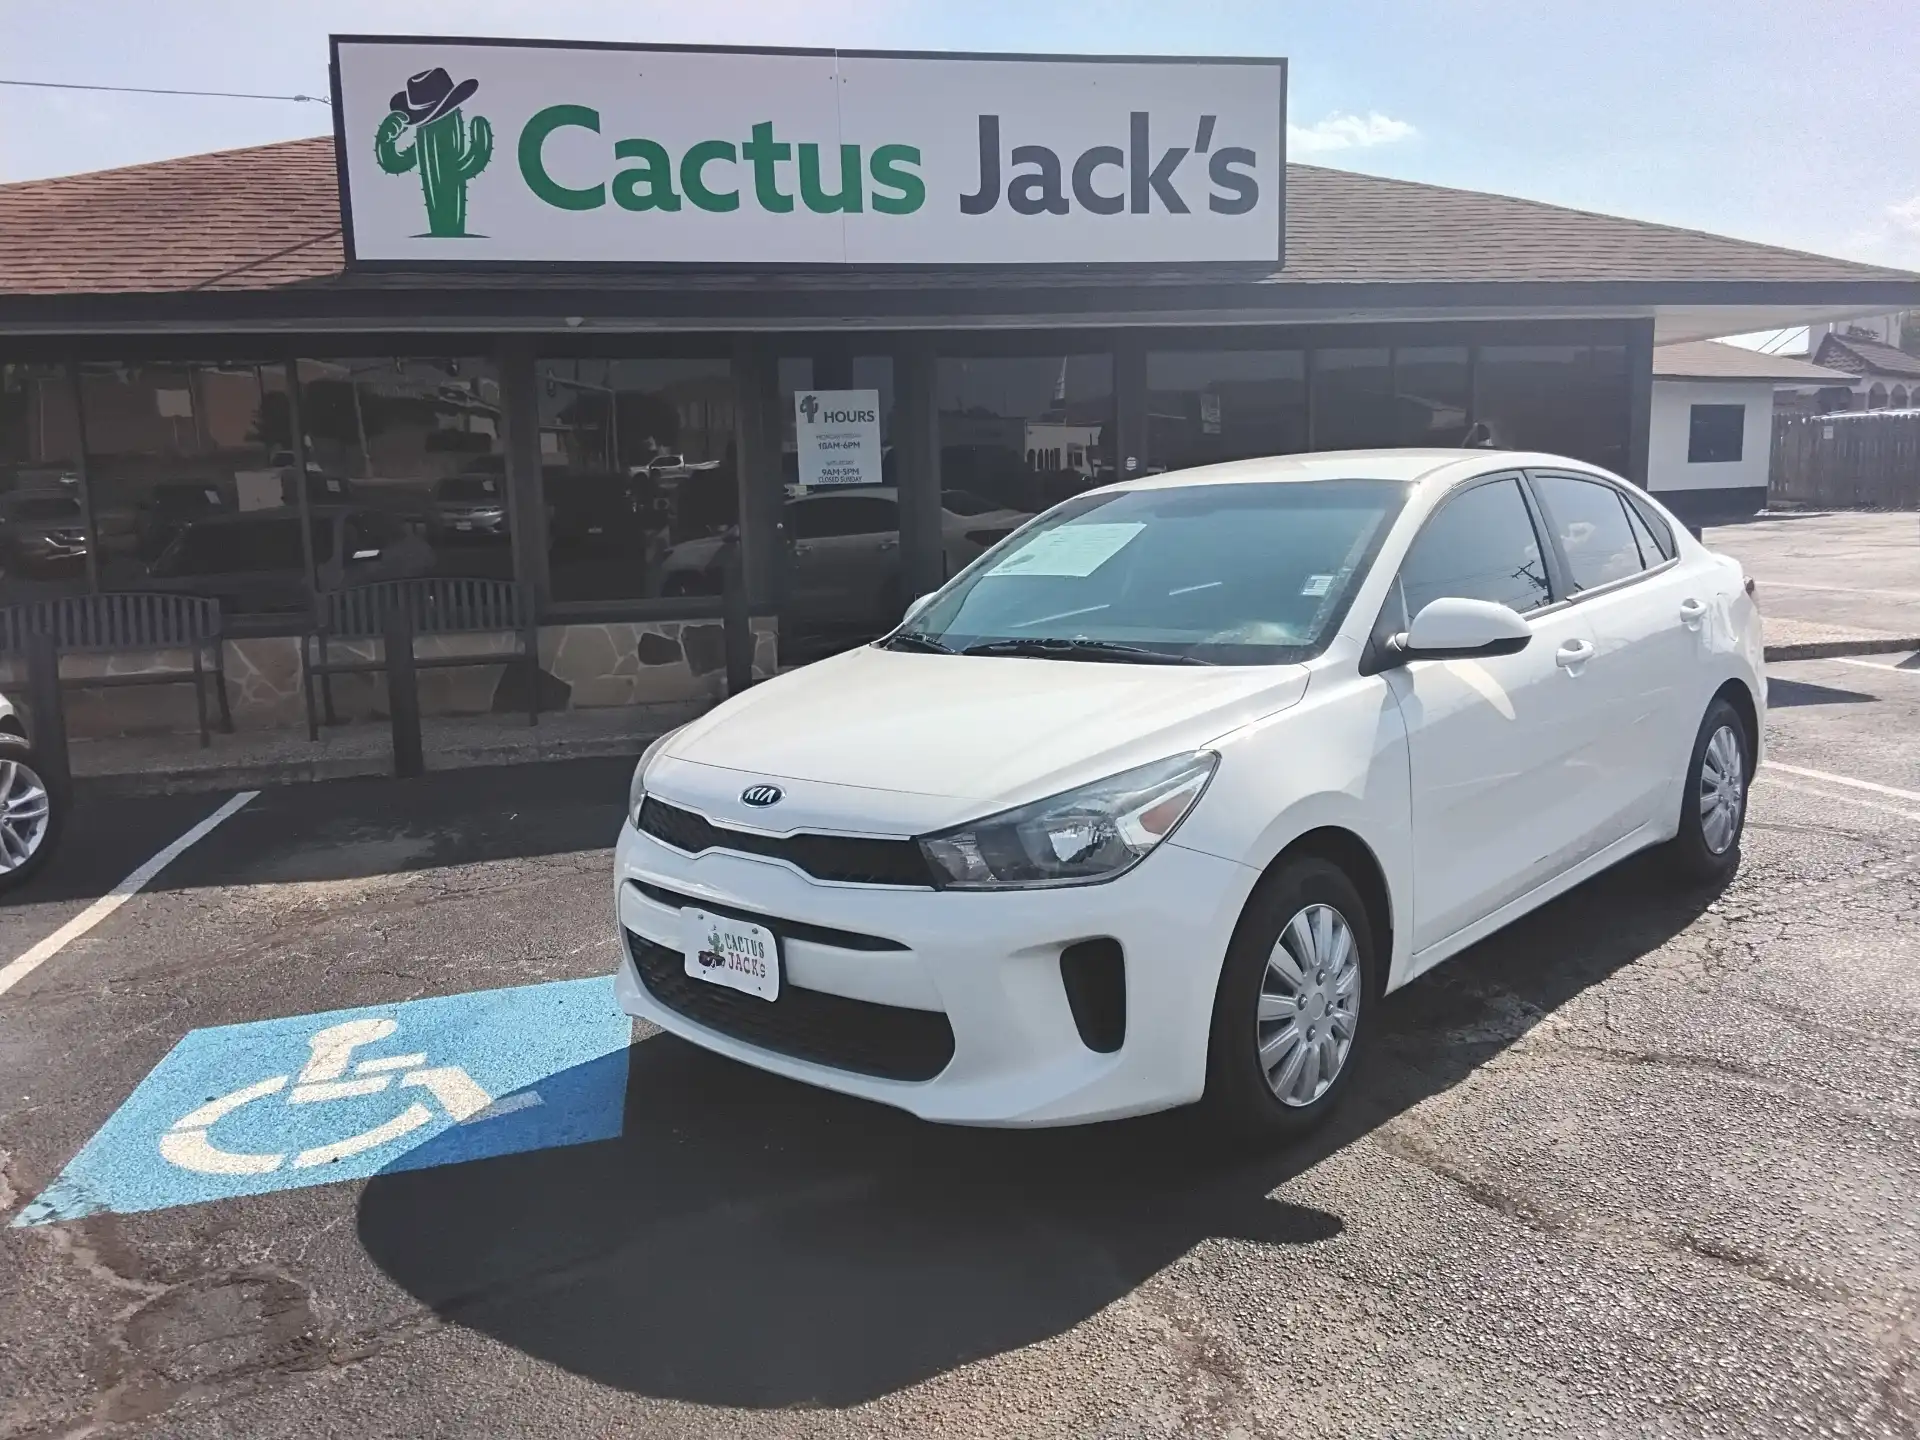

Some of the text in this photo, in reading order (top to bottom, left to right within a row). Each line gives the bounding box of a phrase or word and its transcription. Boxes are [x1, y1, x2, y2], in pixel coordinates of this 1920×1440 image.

[517, 104, 1260, 216] Cactus Jack's
[823, 410, 875, 423] HOURS
[818, 441, 861, 450] 10AM-6PM
[821, 468, 860, 476] 9AM-5PM
[724, 933, 765, 959] CACTUS
